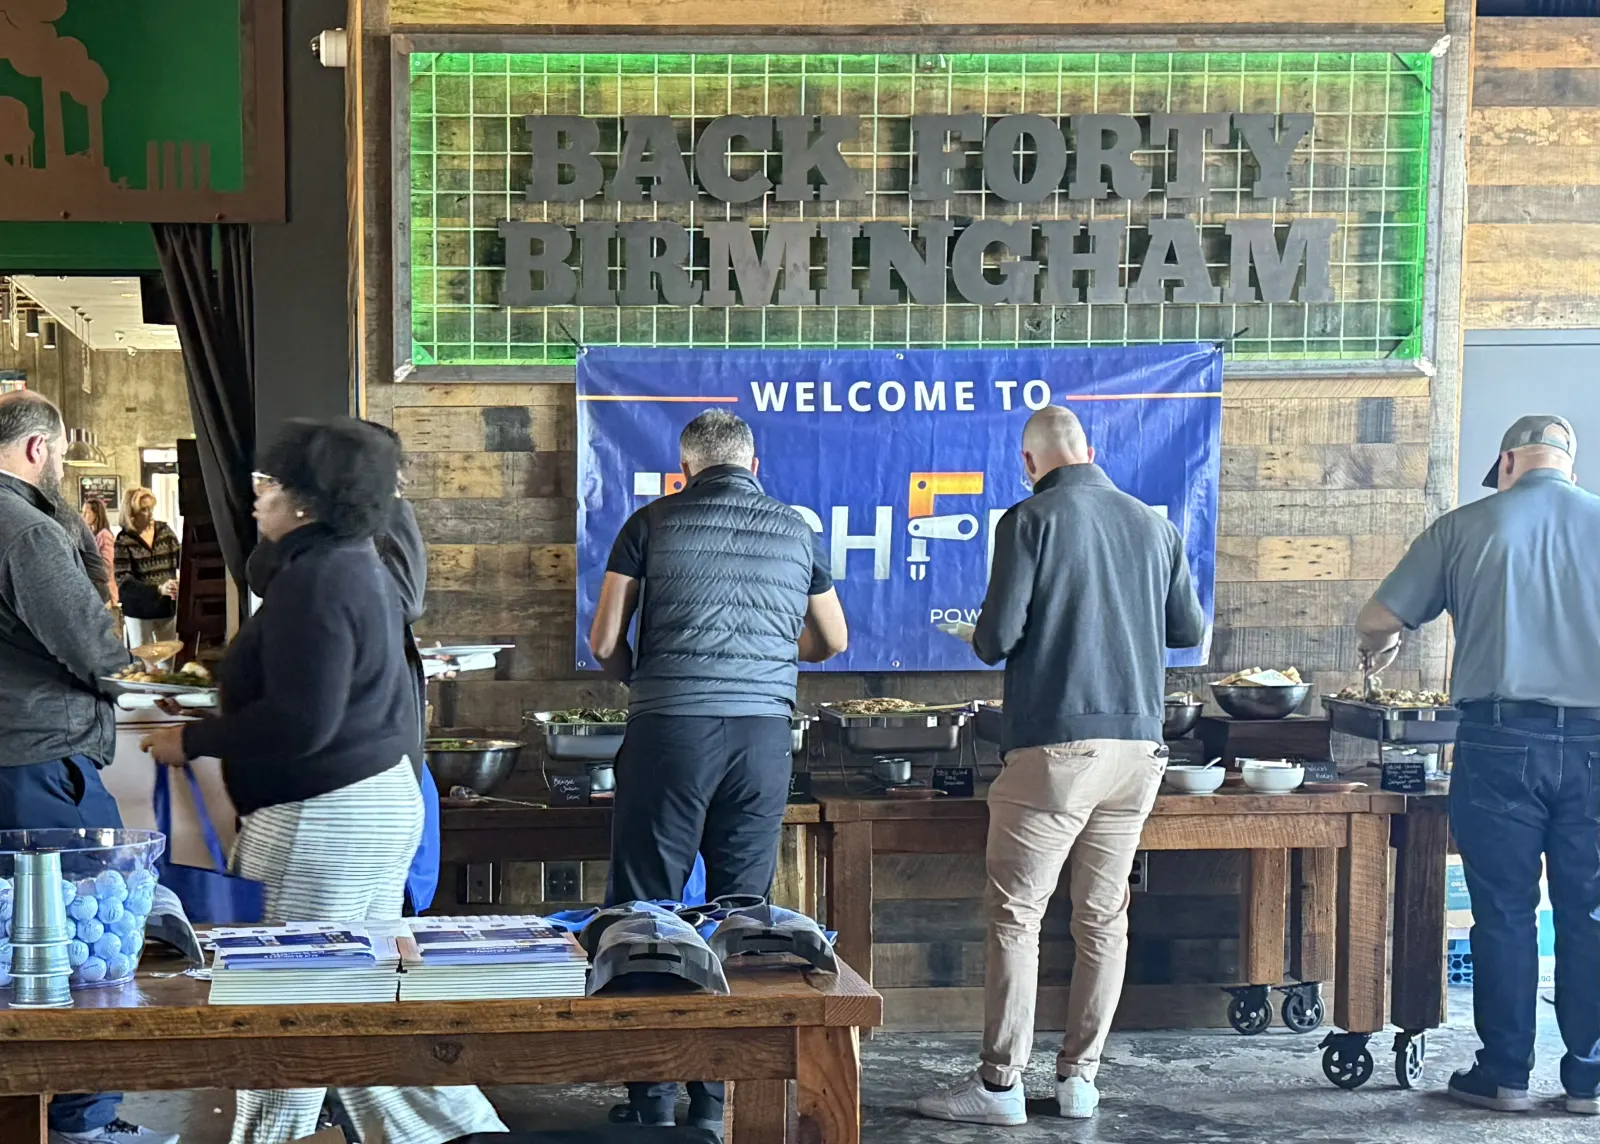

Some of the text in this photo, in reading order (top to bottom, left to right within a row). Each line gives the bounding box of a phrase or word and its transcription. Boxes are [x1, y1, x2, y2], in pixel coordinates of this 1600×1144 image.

[525, 112, 1314, 201] BACK FORTY
[499, 217, 1337, 306] BIRMINGHAM
[750, 379, 1051, 412] WELCOME TO
[930, 608, 983, 624] POW
